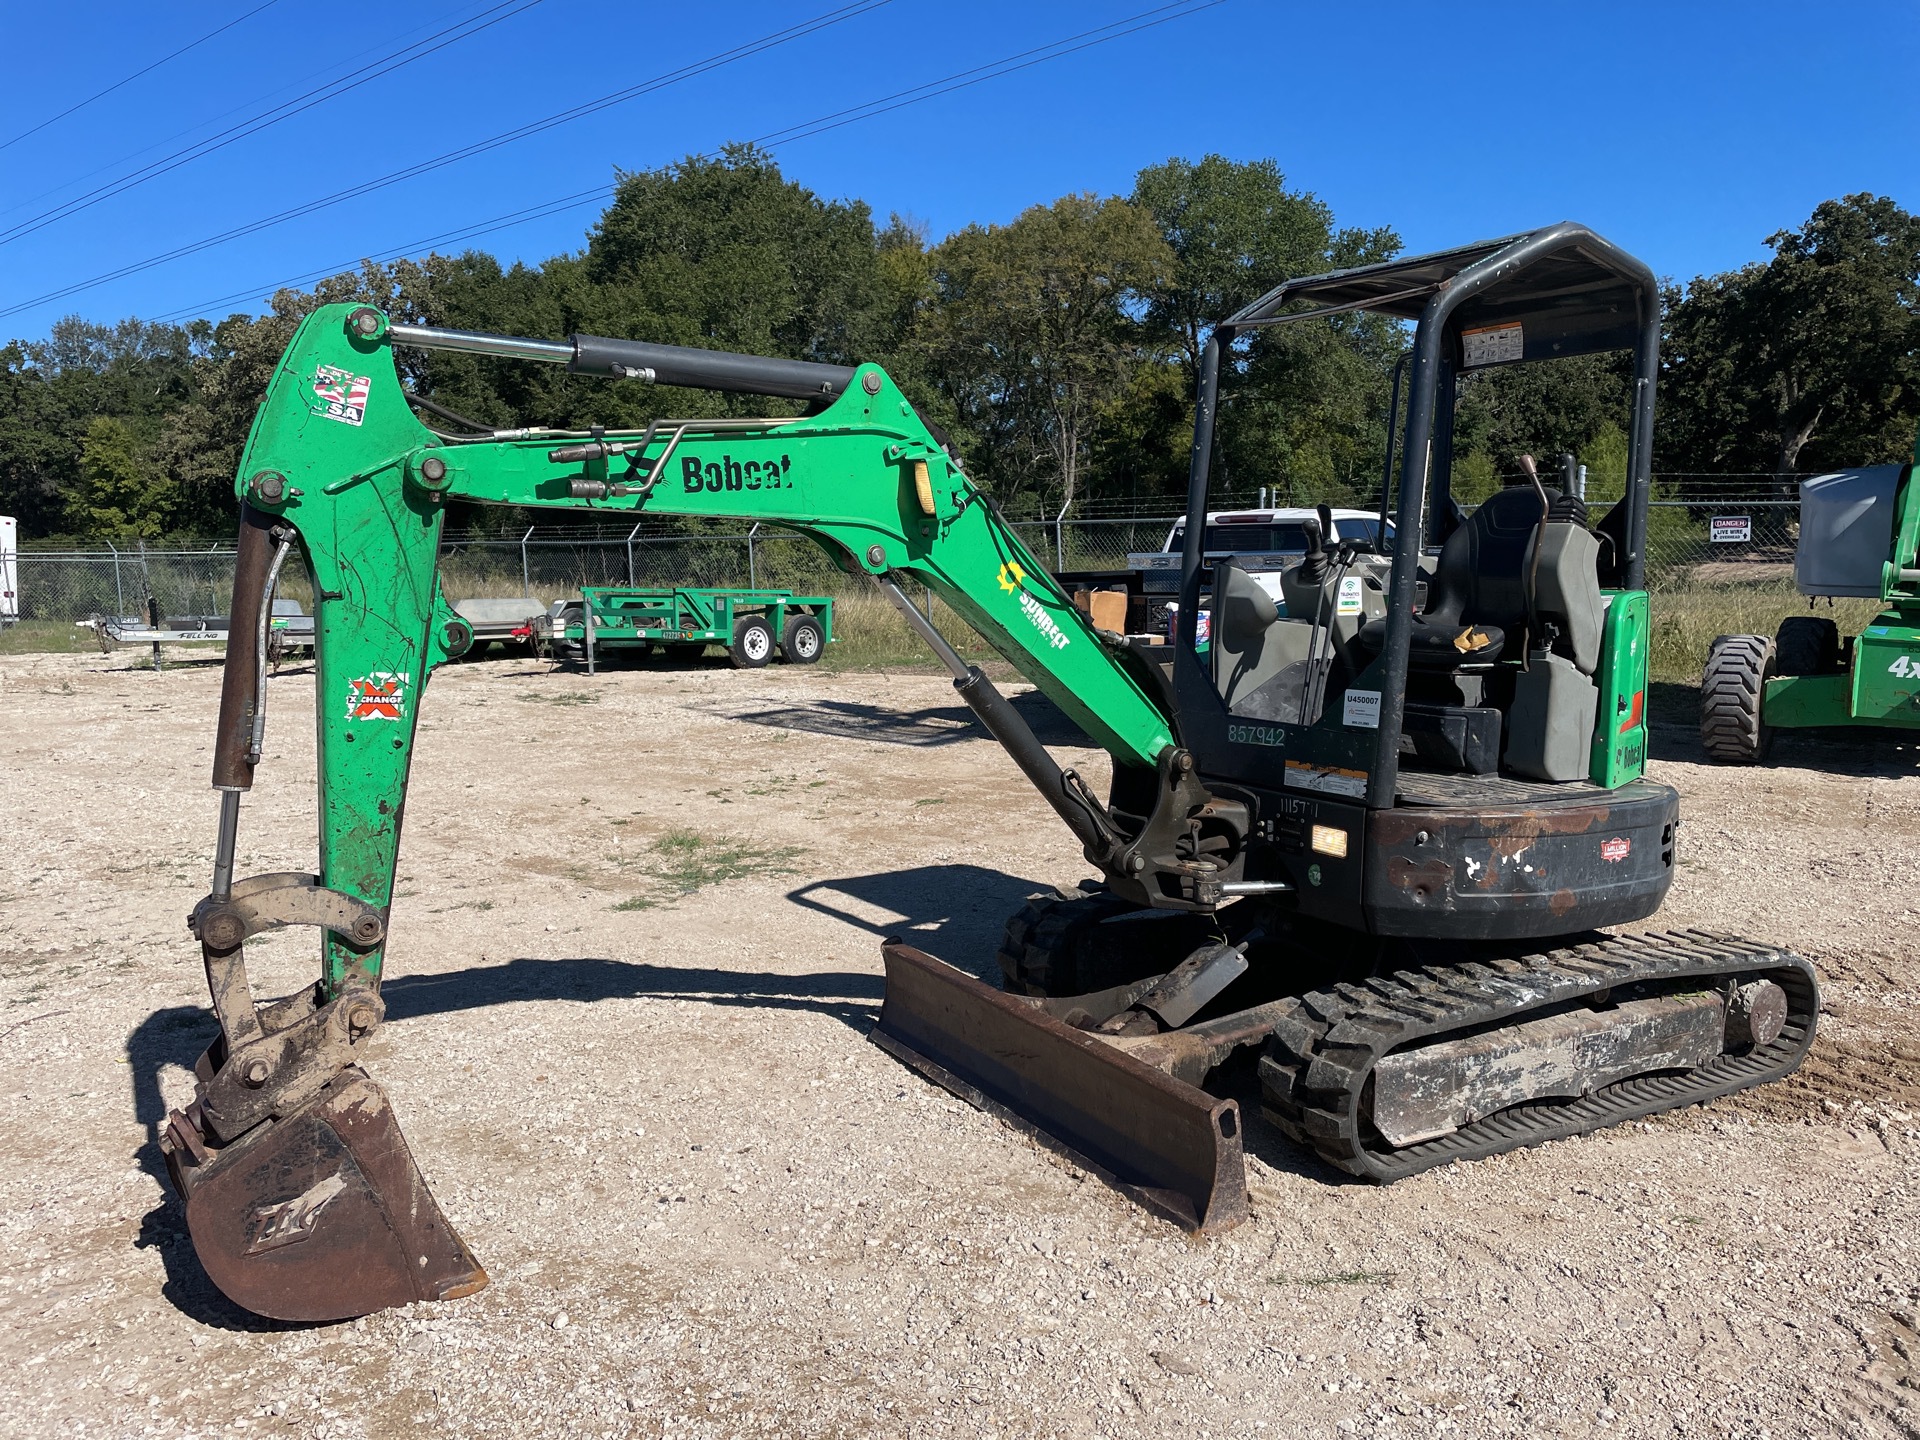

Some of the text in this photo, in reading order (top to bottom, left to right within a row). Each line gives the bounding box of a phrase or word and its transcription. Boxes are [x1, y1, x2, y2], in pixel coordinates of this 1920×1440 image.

[681, 454, 793, 493] Bobcat
[177, 631, 218, 639] FELLNG
[1018, 592, 1071, 650] SUNBELT
[1021, 606, 1057, 648] RENTAS
[1347, 695, 1379, 705] U450007
[1228, 724, 1285, 746] 857942
